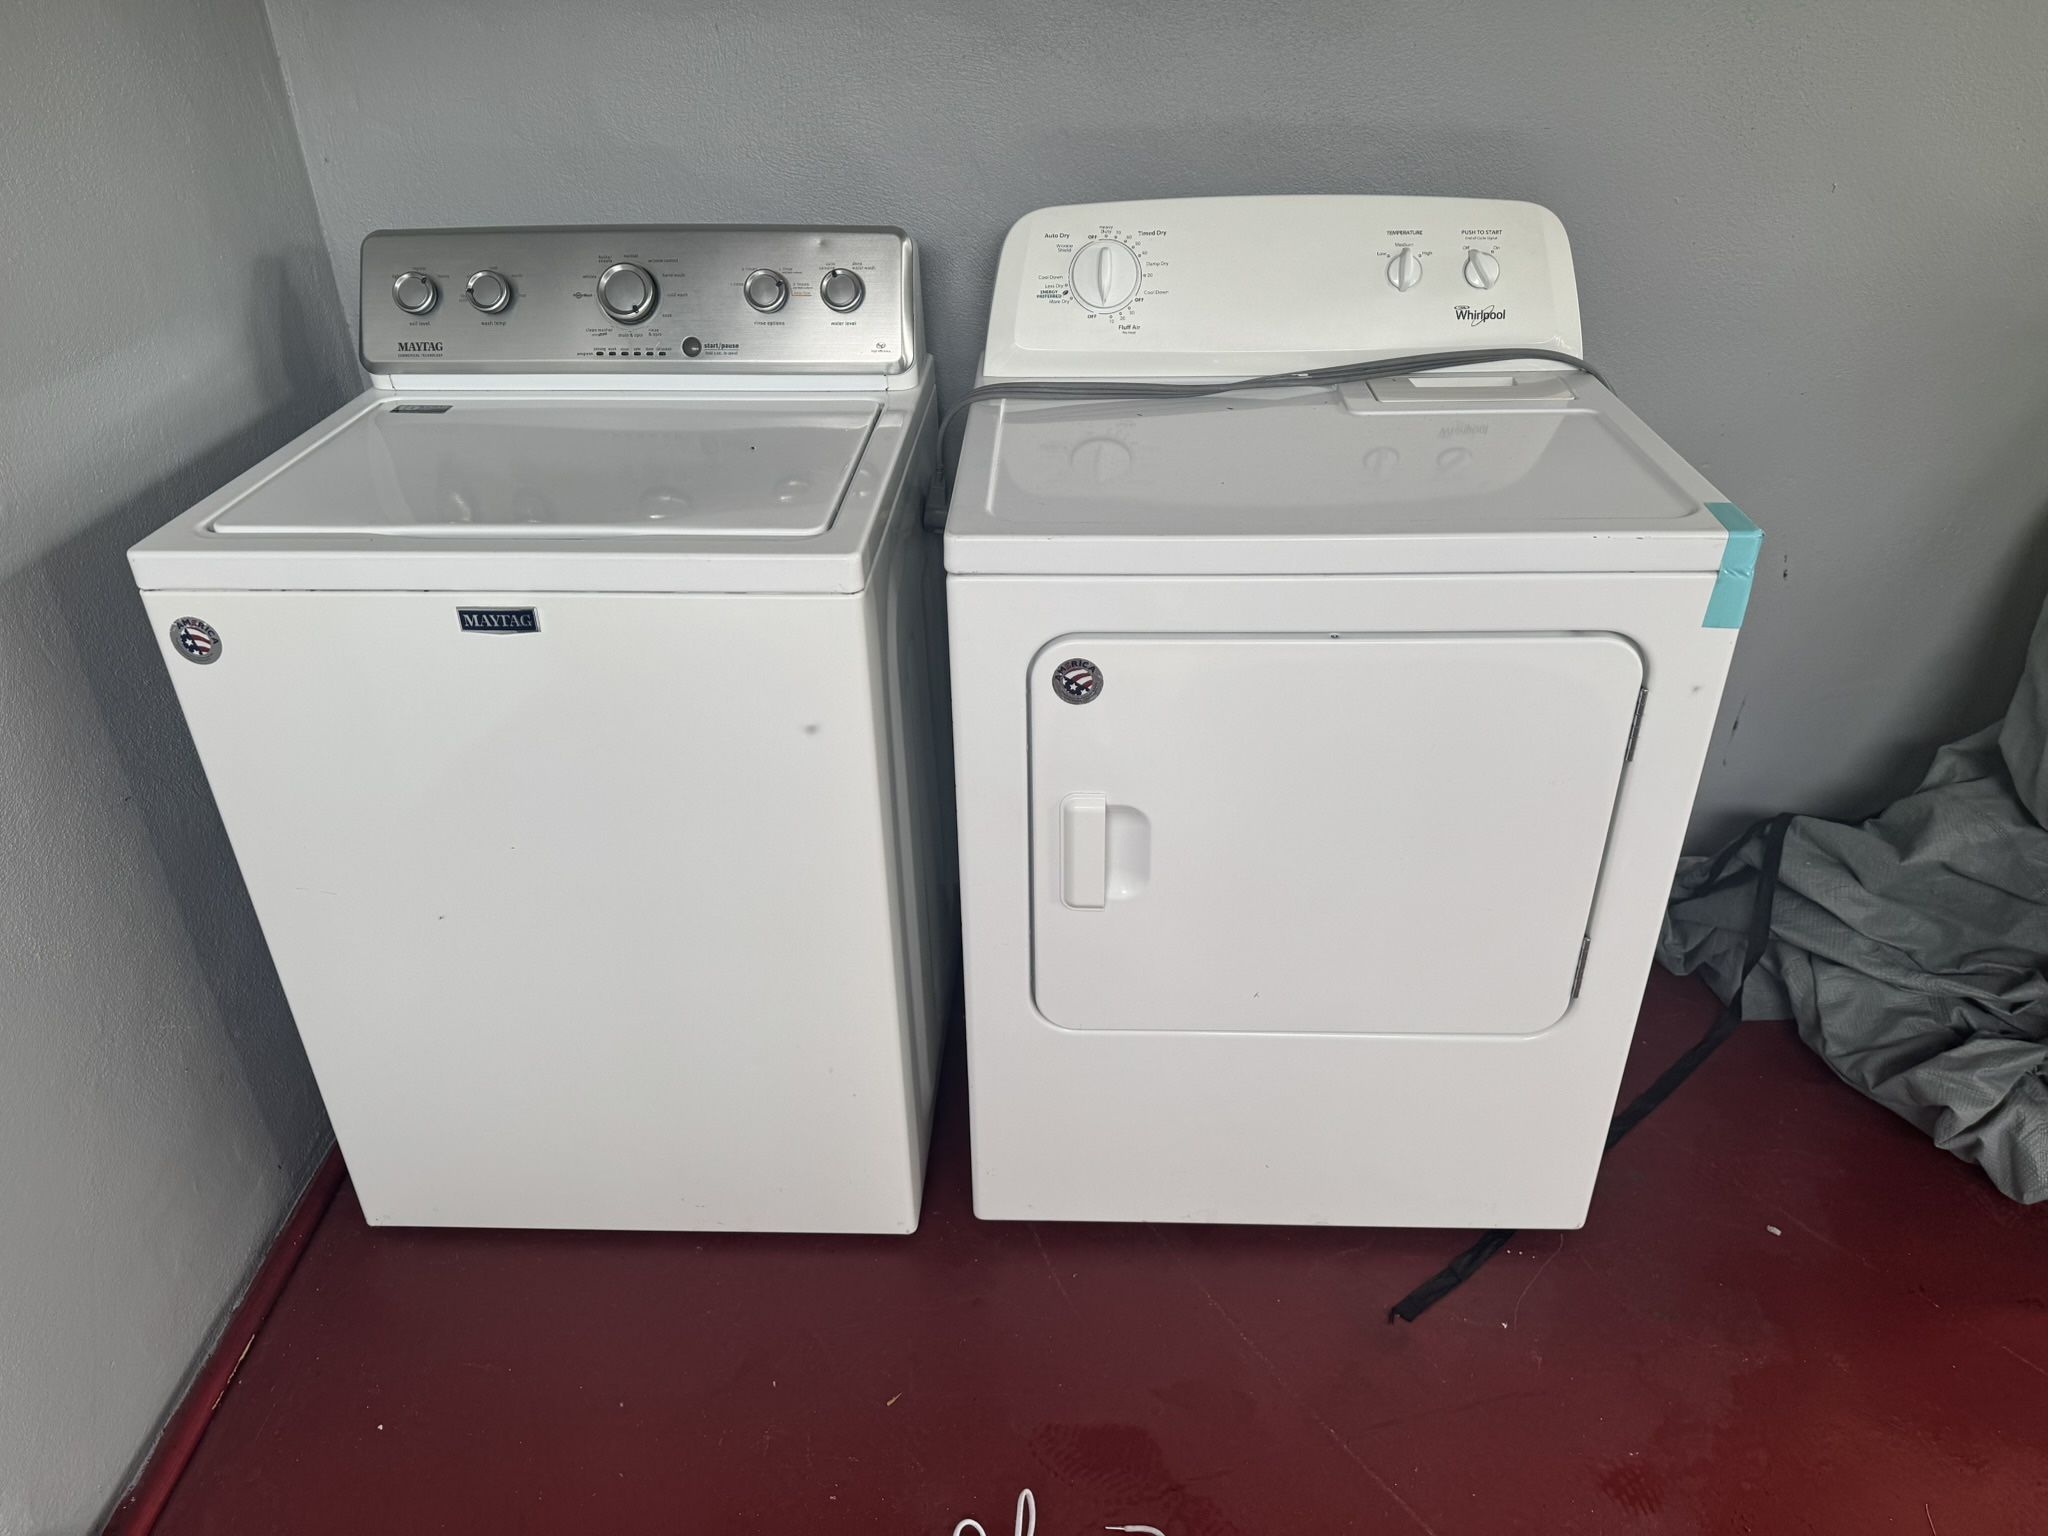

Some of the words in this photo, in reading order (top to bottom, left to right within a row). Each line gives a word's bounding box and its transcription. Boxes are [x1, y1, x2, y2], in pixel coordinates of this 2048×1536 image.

[1455, 308, 1506, 323] Whirlpool
[397, 341, 443, 352] MAYTAG
[703, 342, 740, 351] start/pause
[463, 614, 532, 627] MAYTAG
[176, 618, 219, 646] AMERICA
[1055, 659, 1097, 682] AMERICA
